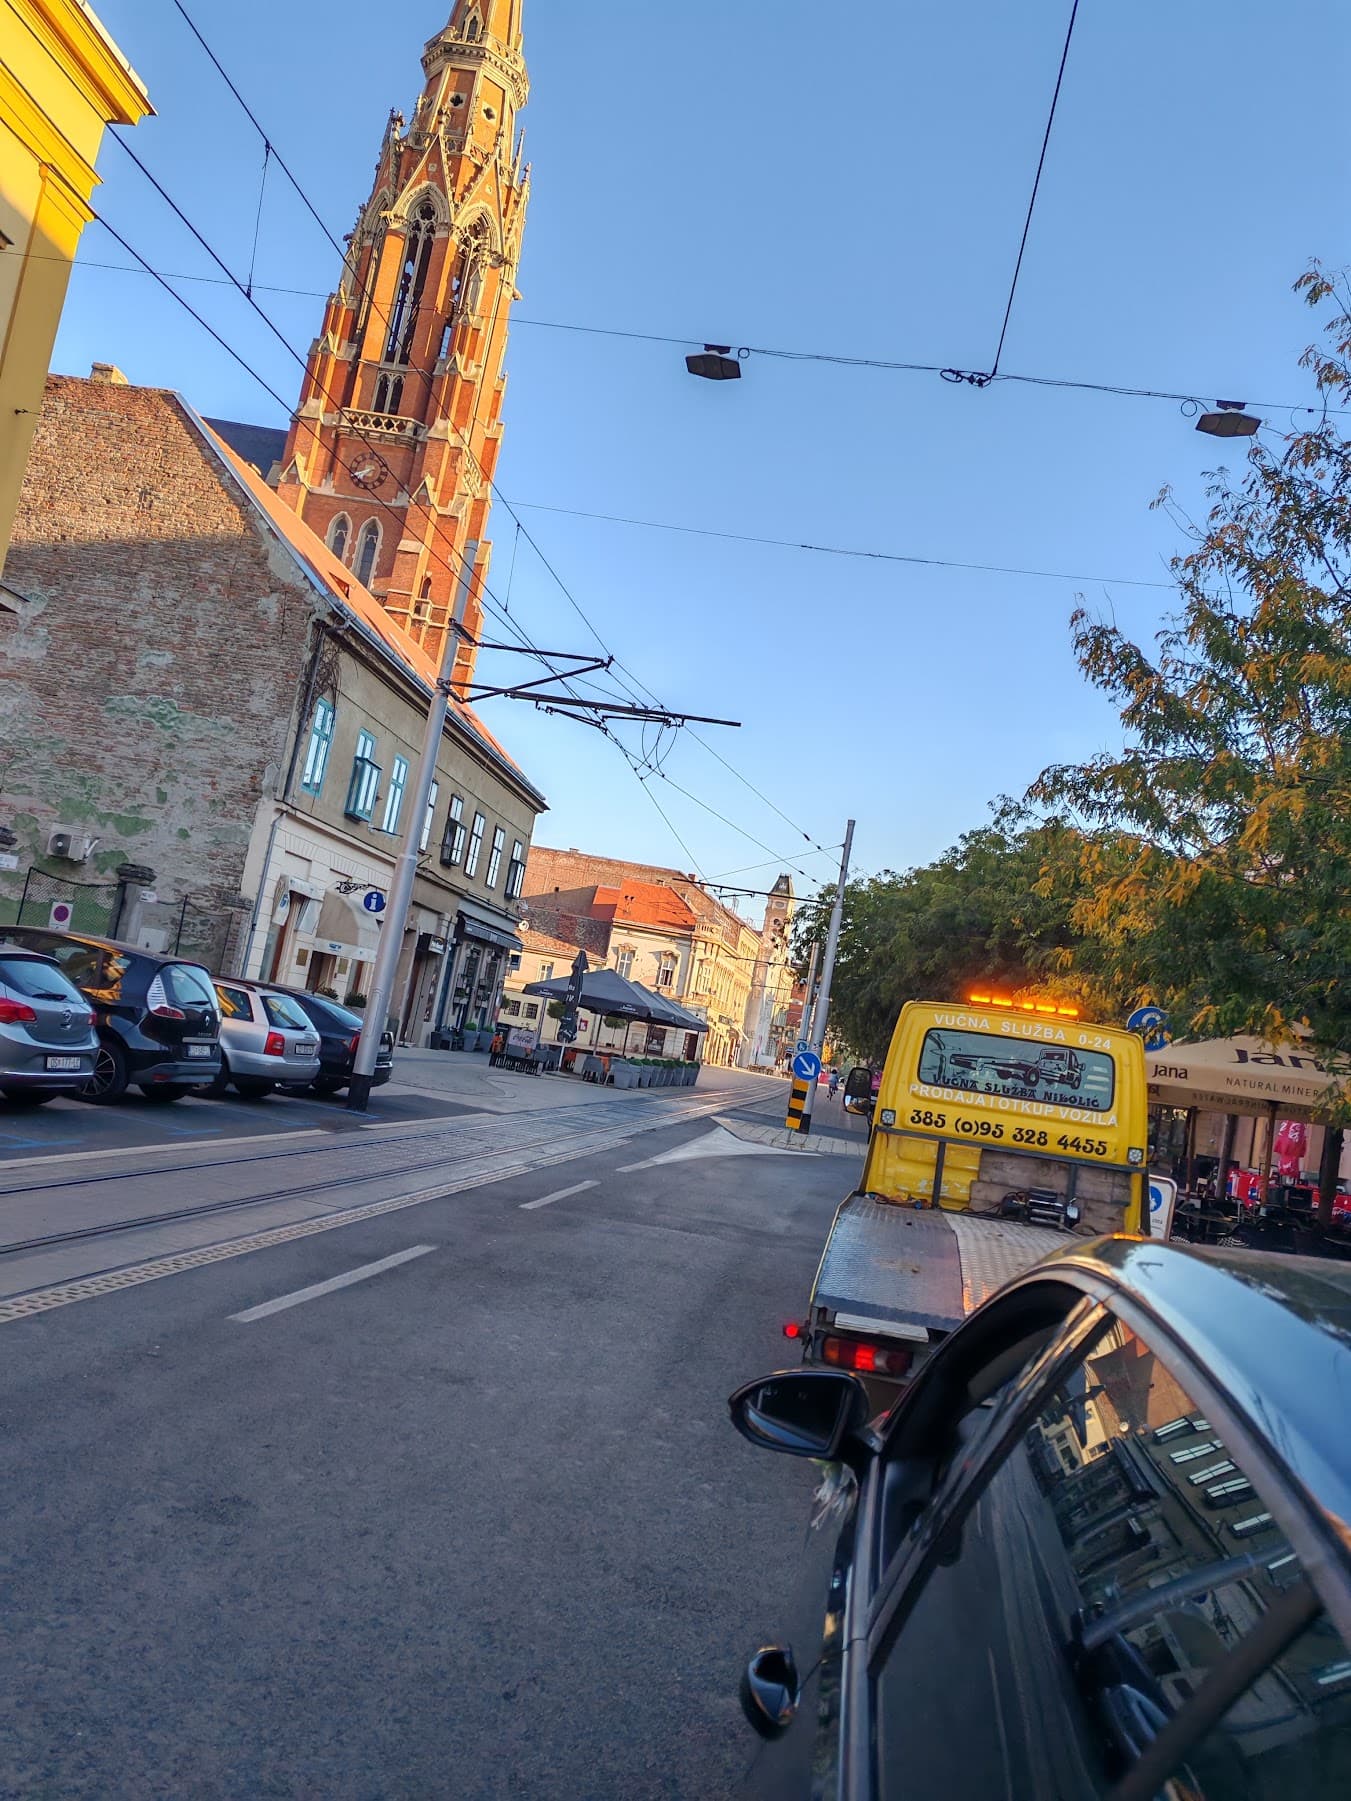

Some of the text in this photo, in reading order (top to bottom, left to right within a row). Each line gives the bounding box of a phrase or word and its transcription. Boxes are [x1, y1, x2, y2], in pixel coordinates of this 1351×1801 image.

[934, 1014, 1112, 1050] VUČNA SLUŽBA 0-24
[1152, 1064, 1188, 1080] Jana
[1226, 1076, 1319, 1098] NATURAL MINER
[909, 1084, 986, 1107] PRODAJA
[997, 1099, 1055, 1118] OTKUP
[1058, 1106, 1119, 1128] VOZILA
[910, 1109, 947, 1129] 385
[1012, 1127, 1049, 1147] 328
[1056, 1134, 1109, 1156] 4455
